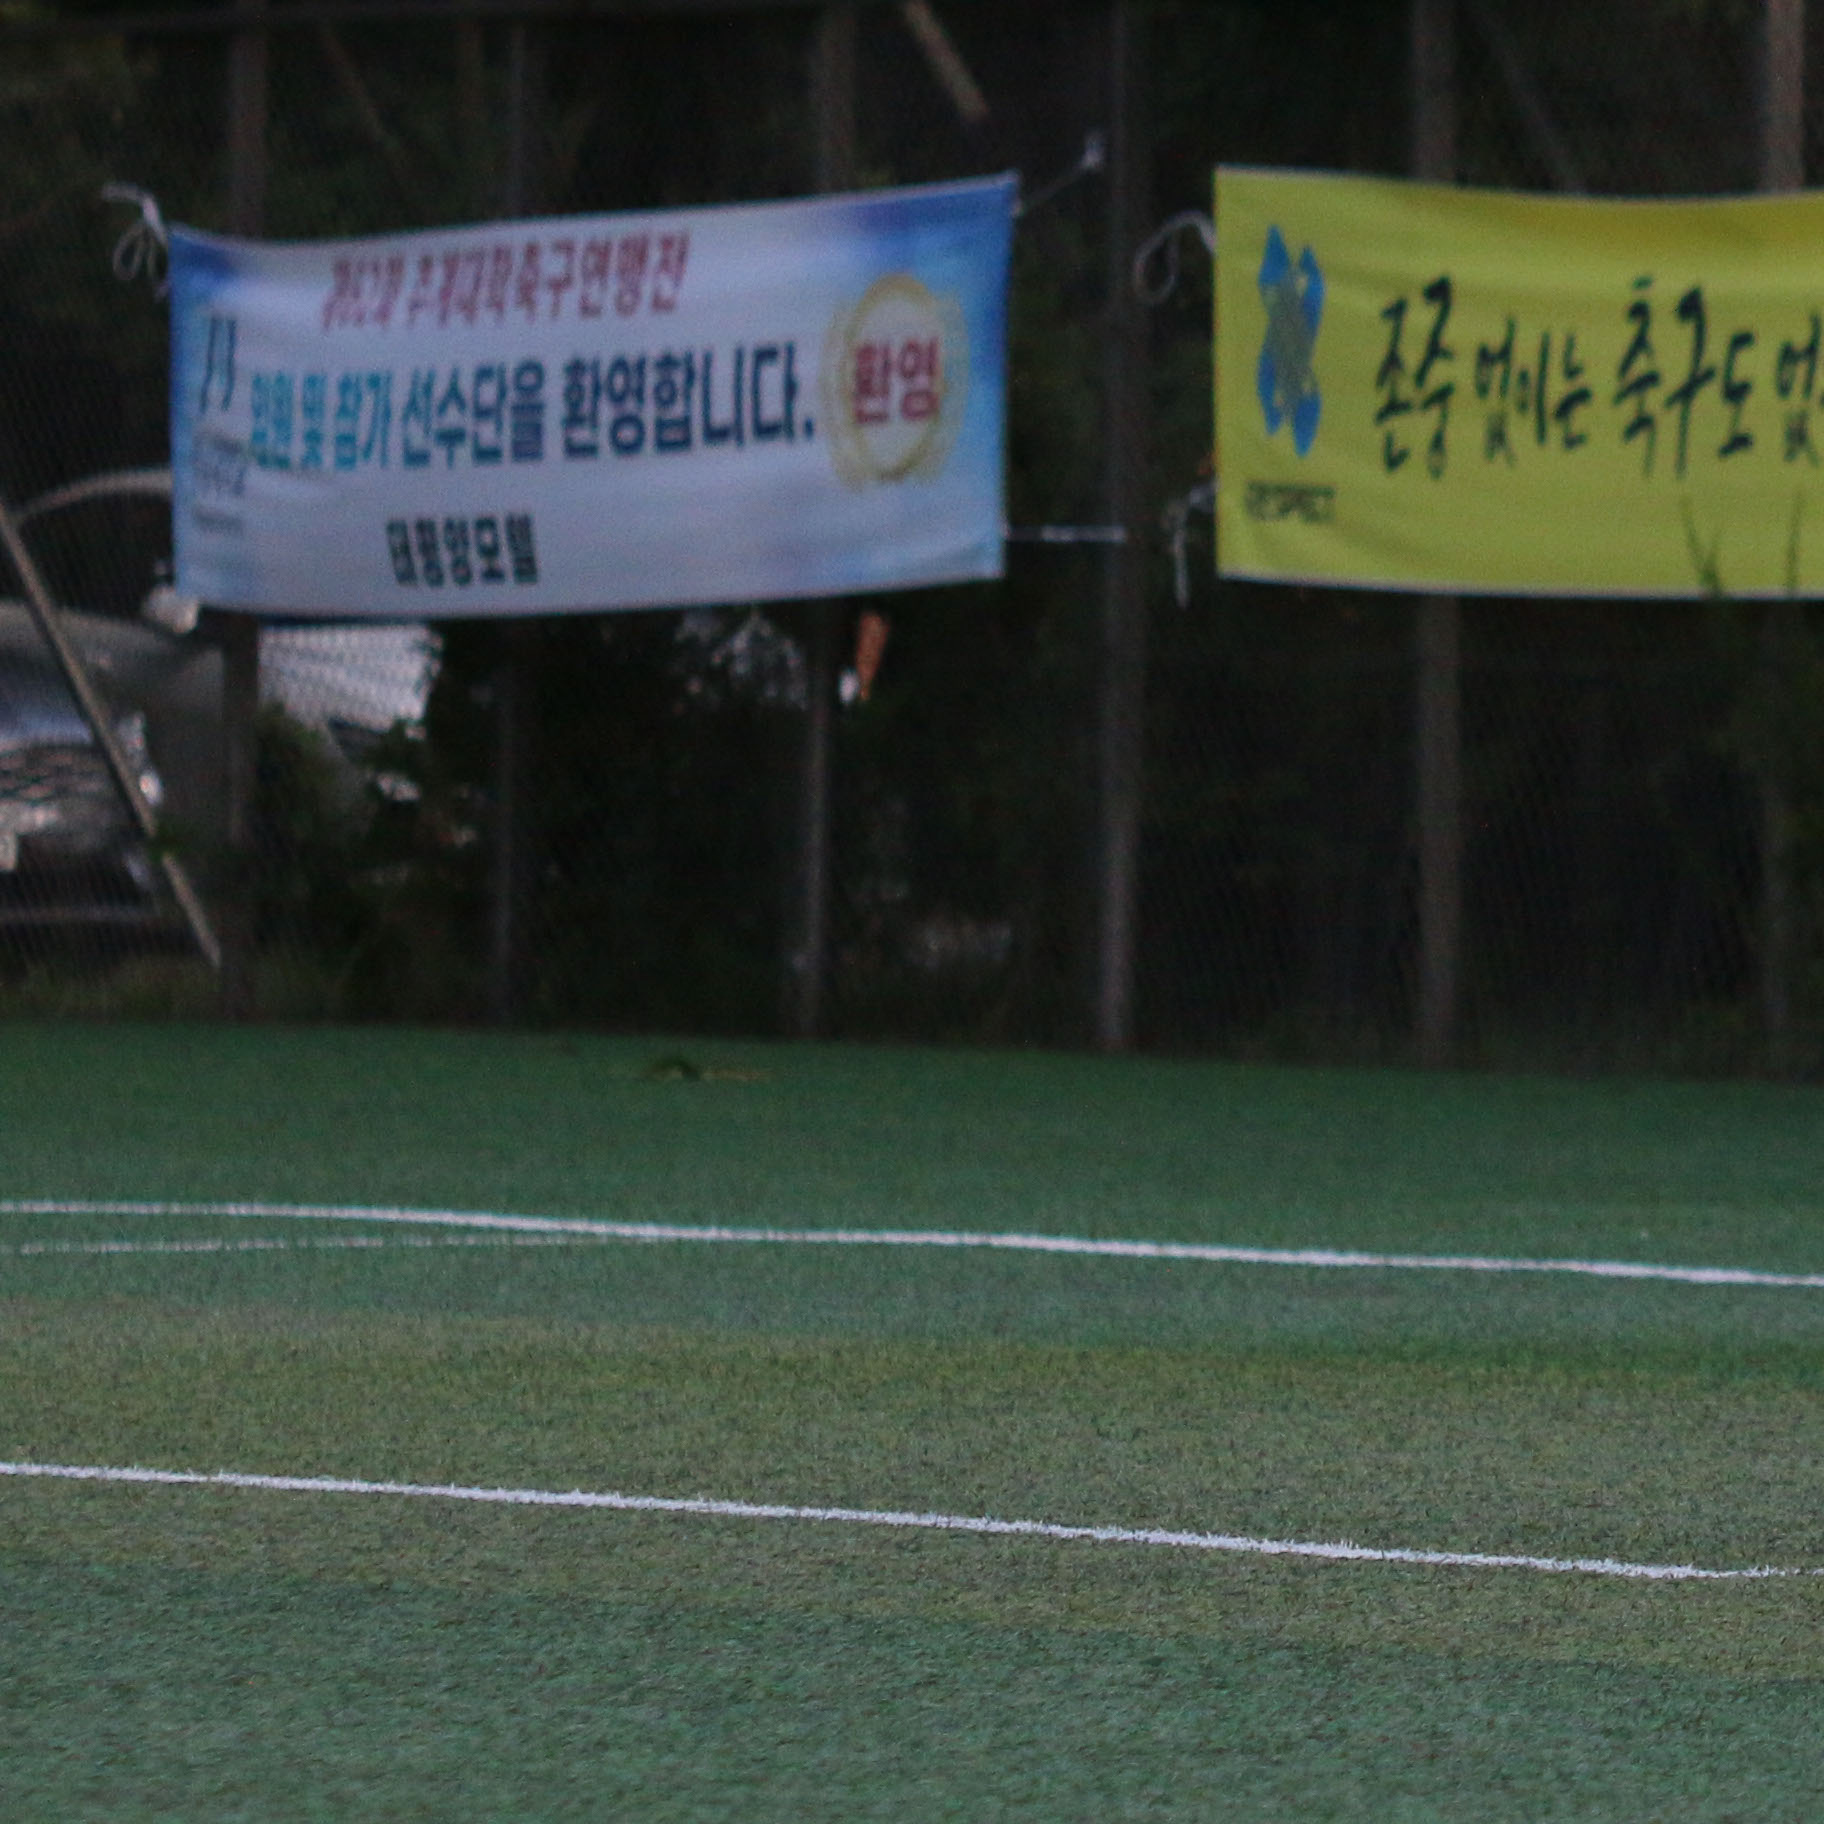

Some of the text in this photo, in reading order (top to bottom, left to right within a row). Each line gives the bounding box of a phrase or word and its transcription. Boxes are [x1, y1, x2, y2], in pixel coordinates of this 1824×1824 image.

[400, 359, 547, 469] 선수단을
[561, 341, 816, 460] 환영합니다.
[853, 337, 943, 425] 환영
[1373, 276, 1456, 481] 존중
[1475, 312, 1592, 466] 없이는
[1613, 273, 1757, 481] 축구도
